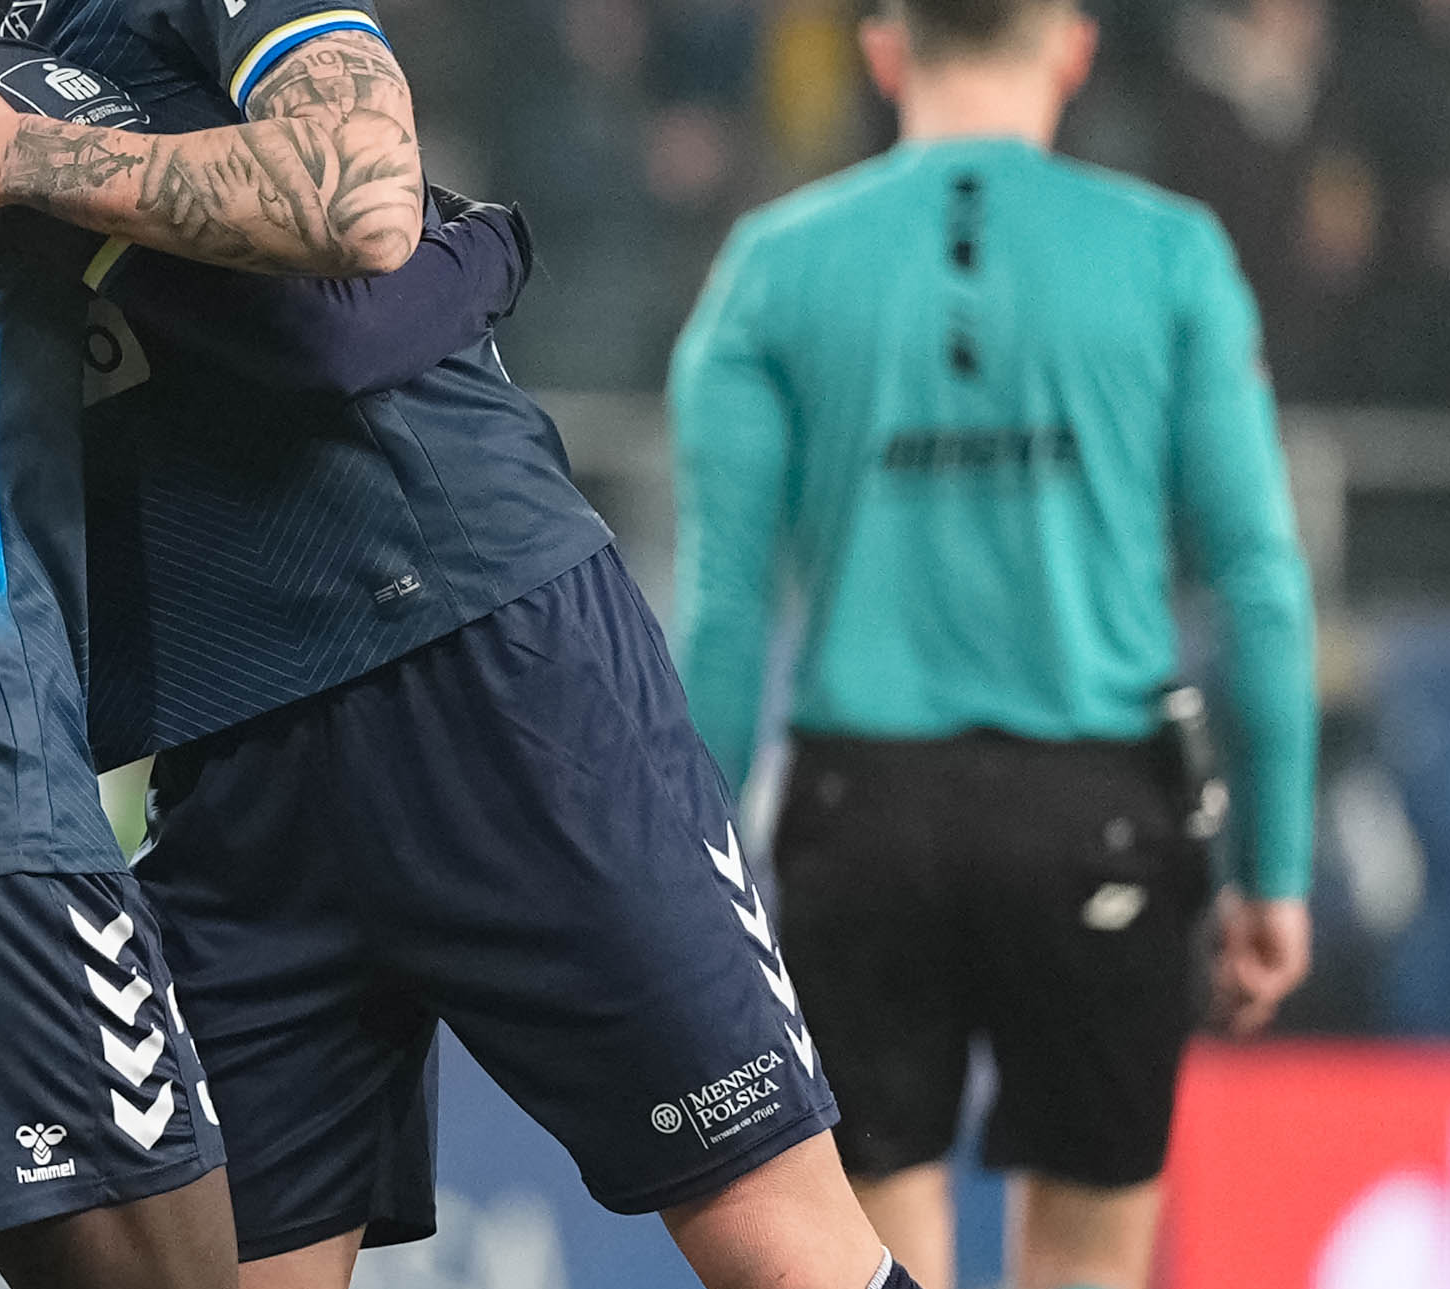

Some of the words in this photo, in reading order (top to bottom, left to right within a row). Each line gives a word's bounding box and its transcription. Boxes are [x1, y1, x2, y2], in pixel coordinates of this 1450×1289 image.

[687, 1050, 784, 1111] MENNICA
[696, 1077, 780, 1129] POLSKA
[16, 1158, 76, 1184] hummel
